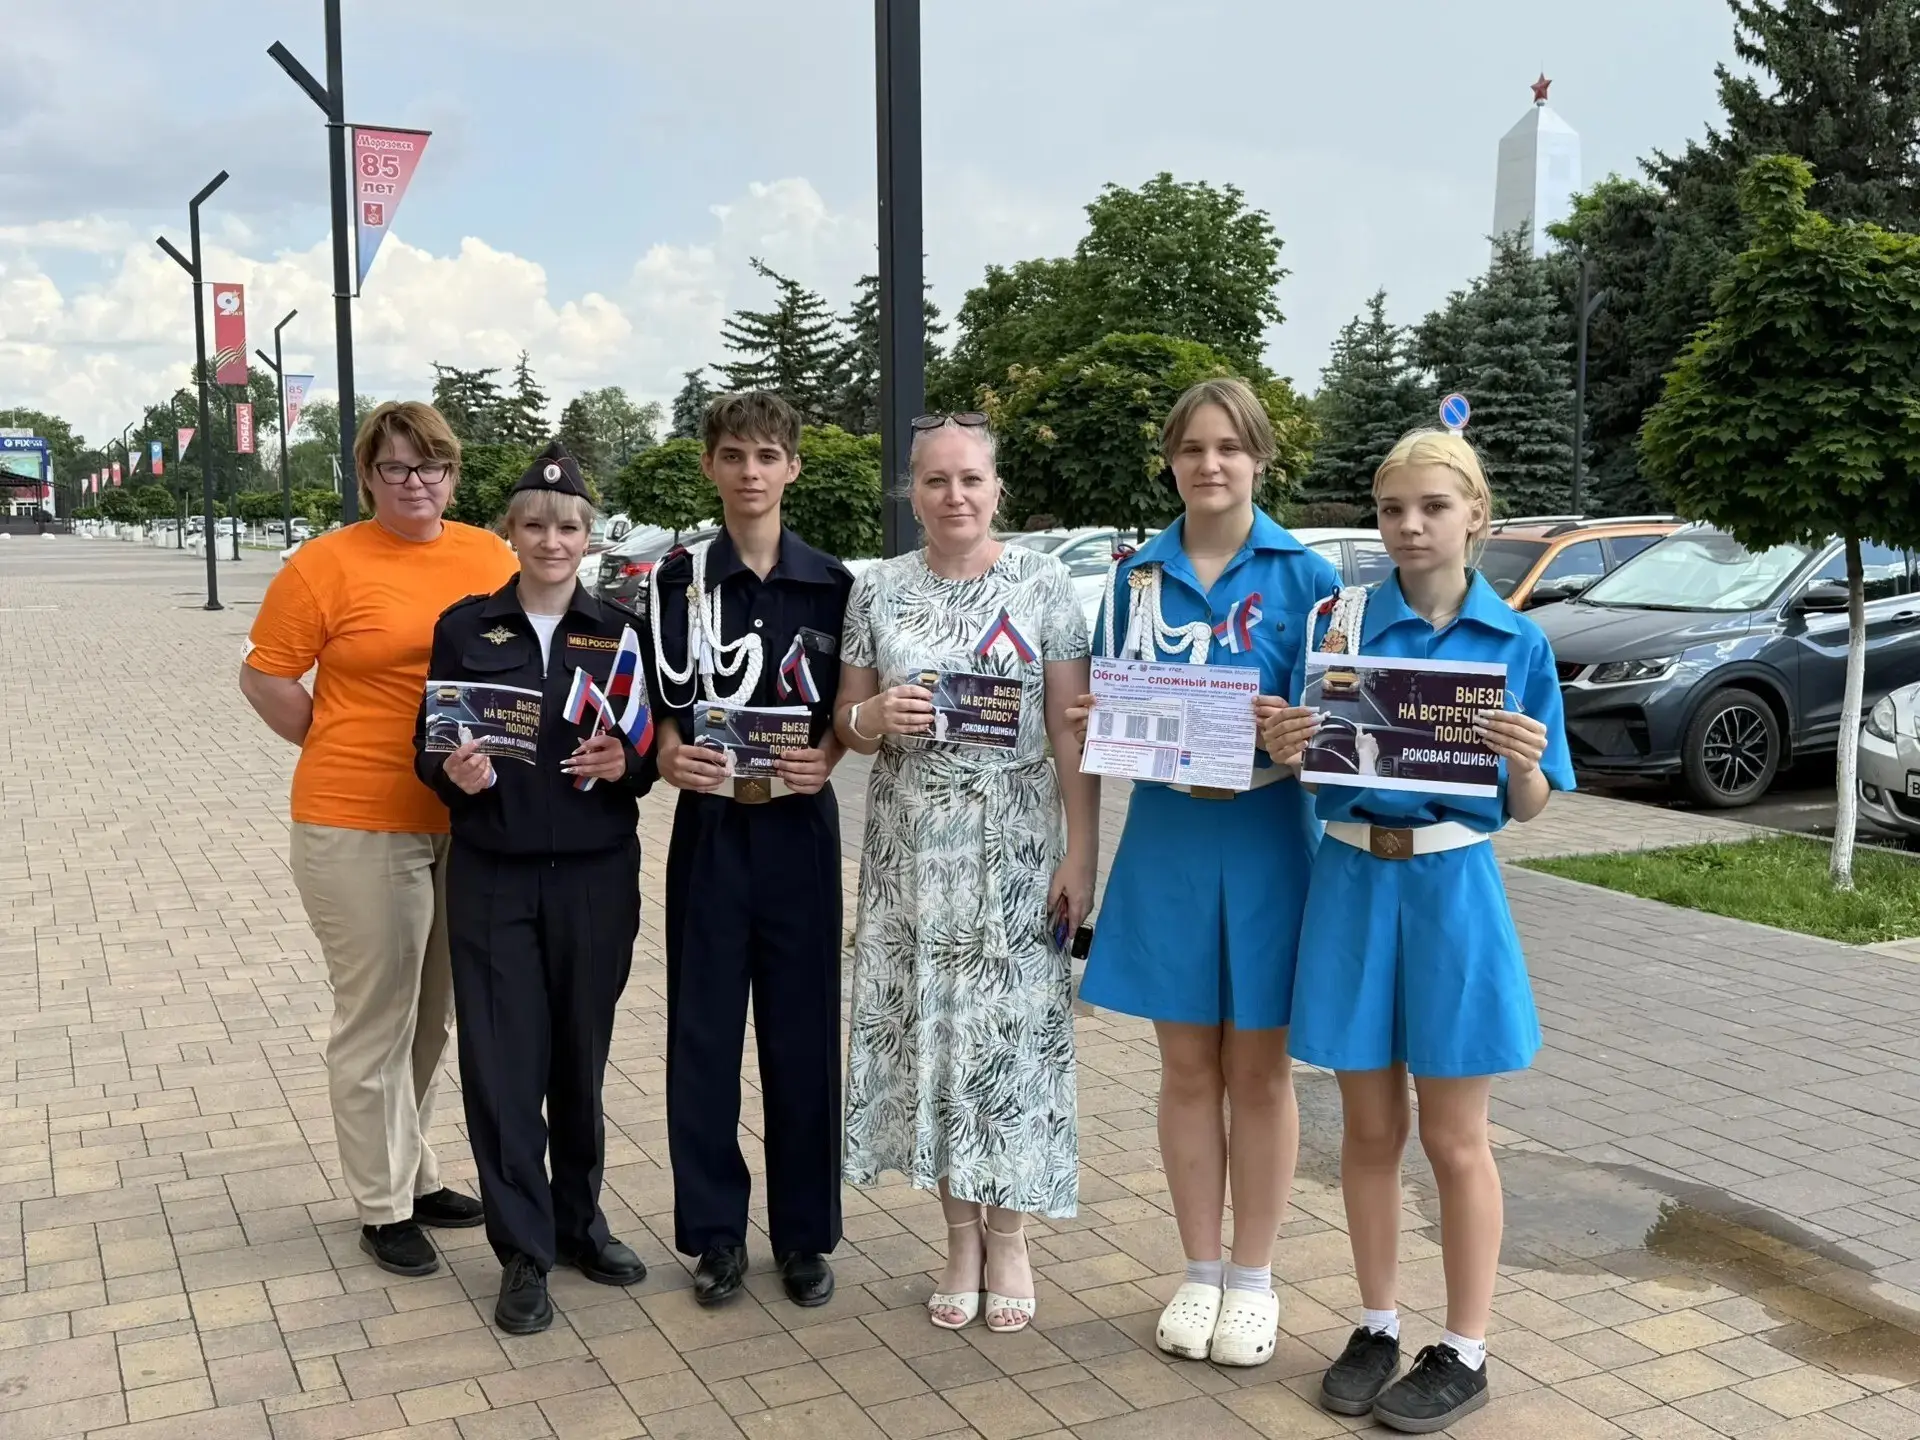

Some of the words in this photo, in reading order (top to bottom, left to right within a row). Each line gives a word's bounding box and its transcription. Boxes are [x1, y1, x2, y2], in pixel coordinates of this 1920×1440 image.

[358, 135, 413, 150] Морозовск
[361, 153, 400, 179] 85
[362, 182, 396, 194] лет
[216, 291, 240, 315] 9
[240, 406, 250, 450] ПОБЕДА!
[15, 439, 30, 447] FIX
[570, 636, 588, 647] МВД
[1093, 669, 1128, 682] Обгон
[1148, 675, 1207, 688] сложный
[1210, 680, 1258, 692] маневр
[994, 686, 1021, 700] ВЫЕЗД
[1455, 686, 1504, 708] ВЫЕЗД
[516, 700, 541, 716] ВЫЕЗД
[960, 694, 972, 706] НА
[973, 697, 1020, 711] ВСТРЕЧНУЮ
[483, 708, 495, 719] НА
[497, 709, 540, 727] ВСТРЕЧНУЮ
[980, 709, 1012, 722] ПОЛОСУ
[1398, 702, 1417, 720] НА
[505, 722, 535, 737] ПОЛОСУ
[782, 721, 809, 734] ВЫЕЗД
[961, 722, 989, 734] РОКОВАЯ
[990, 726, 1017, 737] ОШИБКА
[487, 736, 516, 747] РОКОВАЯ
[516, 740, 537, 752] ОШИБКА
[748, 731, 760, 741] НА
[762, 733, 809, 745] ВСТРЕЧНУЮ
[1402, 747, 1450, 764] РОКОВАЯ
[1453, 751, 1500, 768] ОШИБКА
